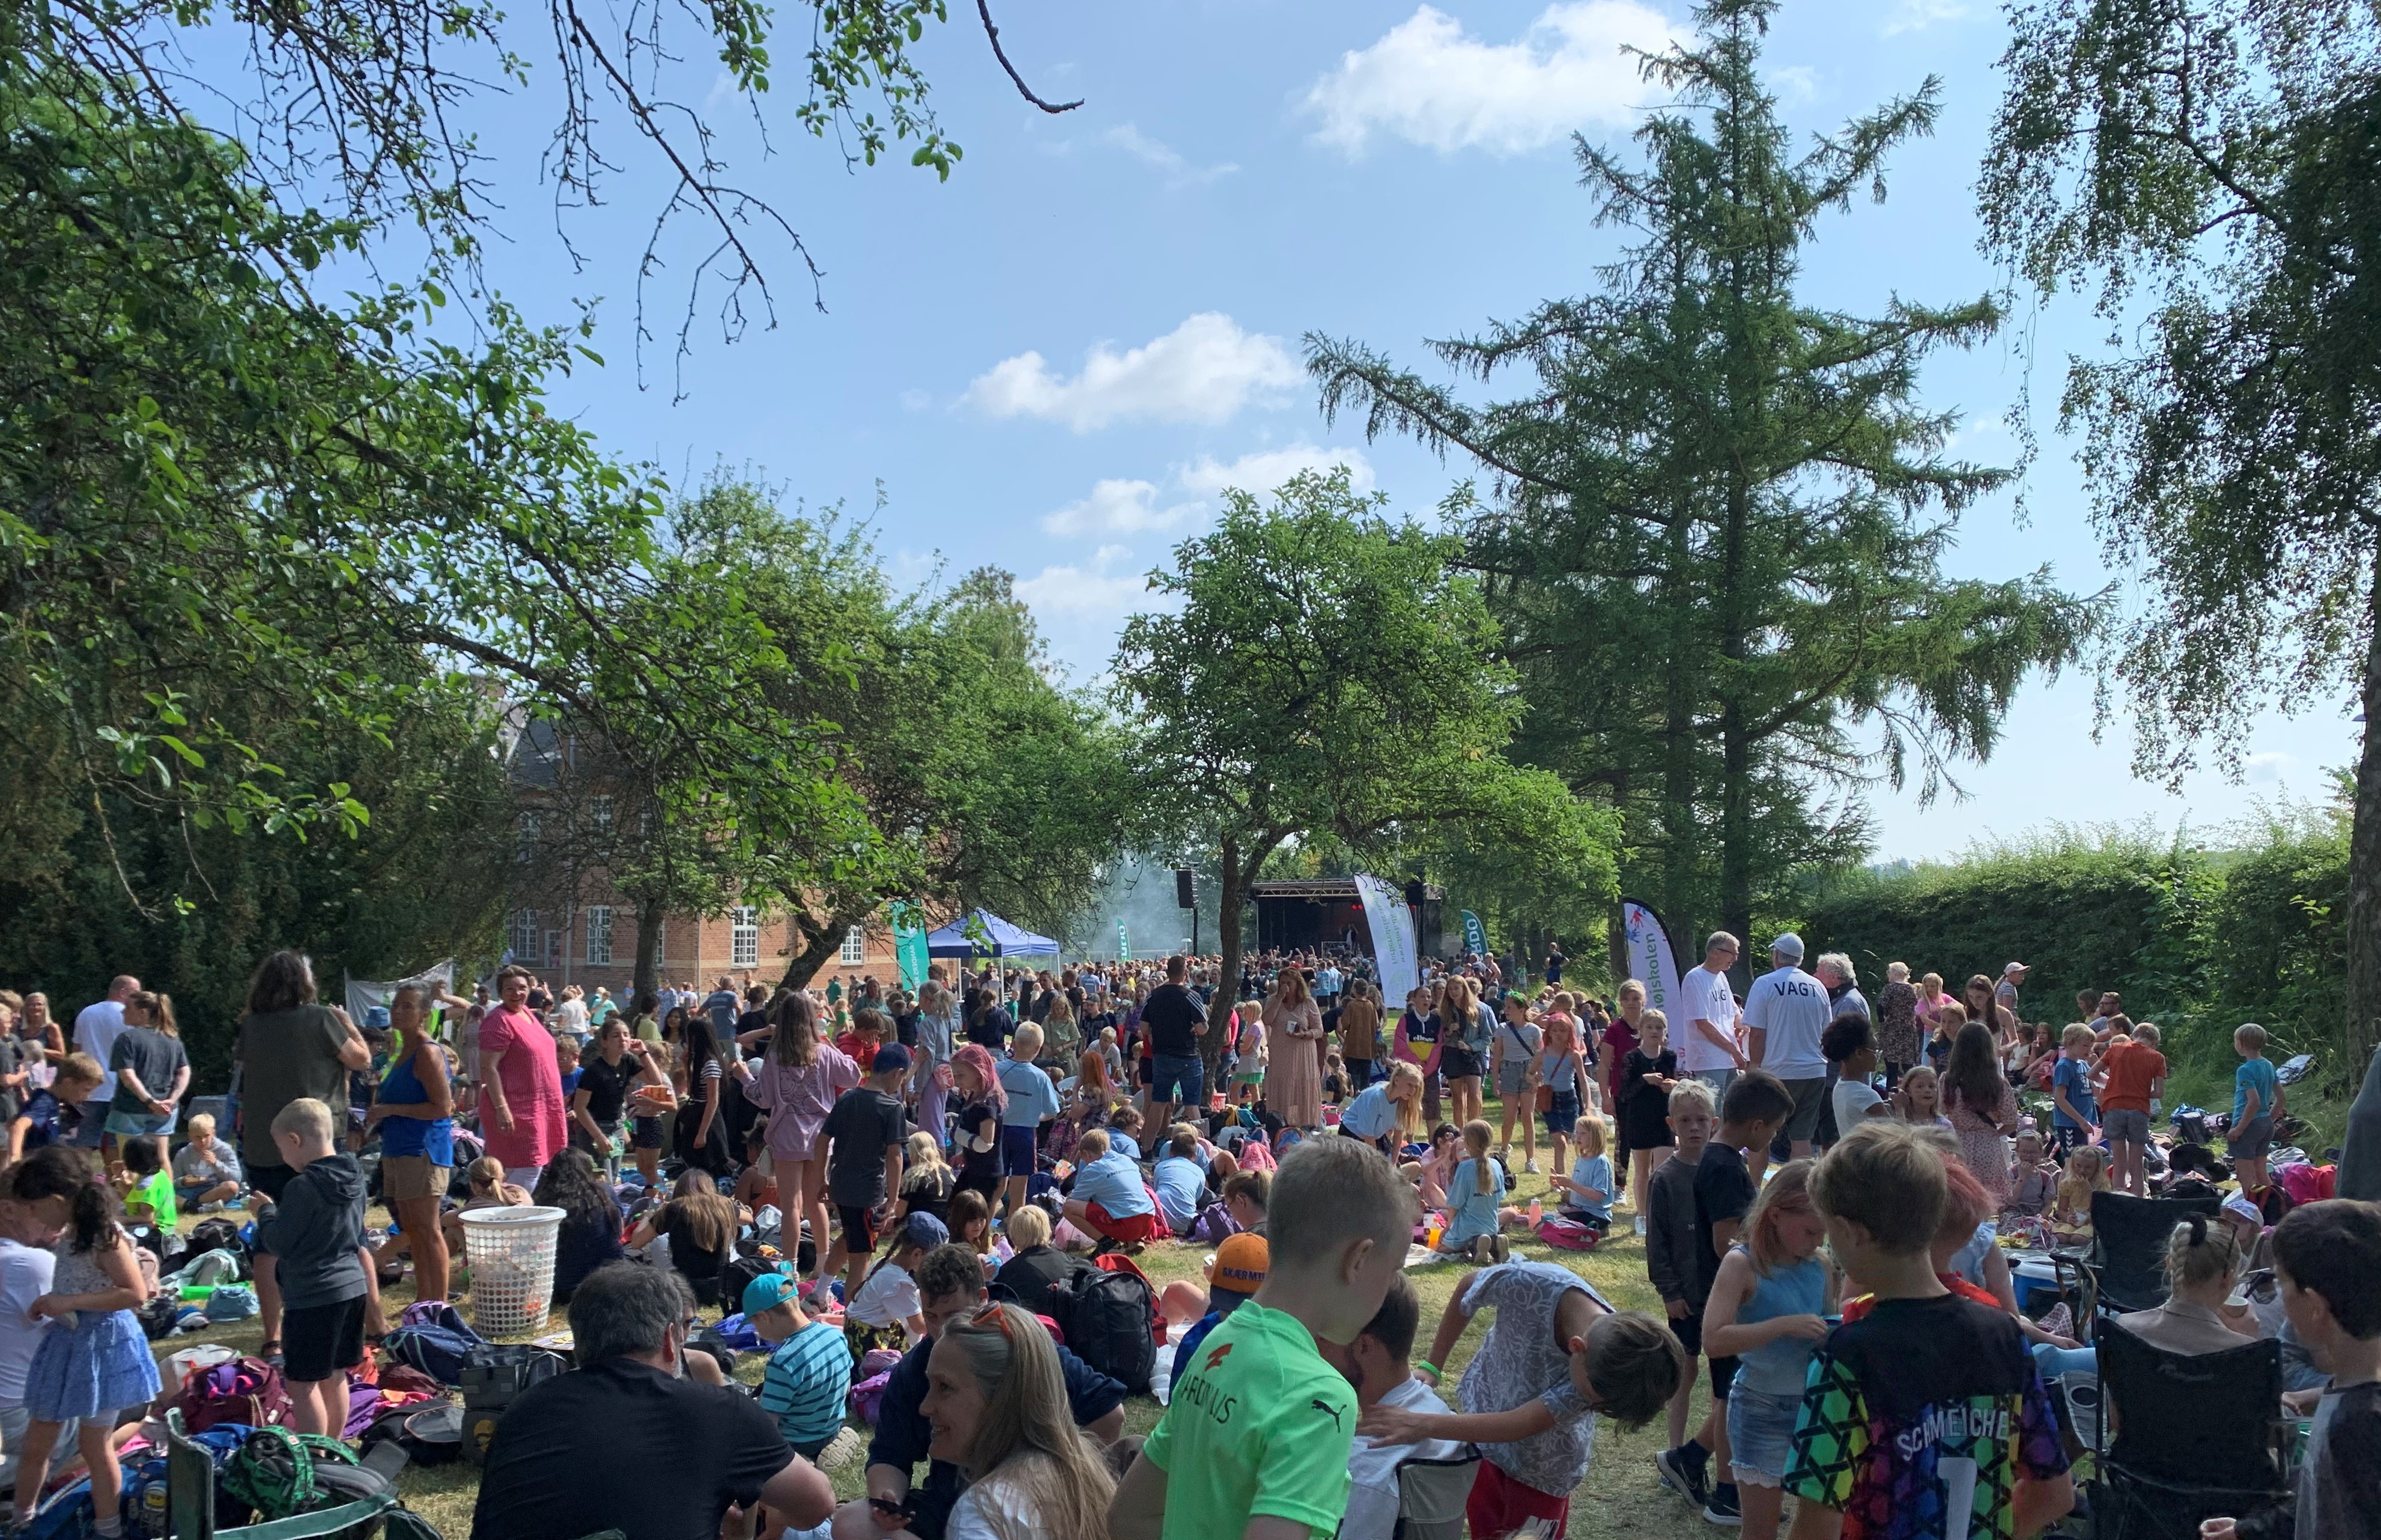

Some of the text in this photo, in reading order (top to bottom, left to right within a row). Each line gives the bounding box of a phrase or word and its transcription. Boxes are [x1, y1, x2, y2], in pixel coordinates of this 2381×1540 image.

[1467, 918, 1484, 961] RDO
[1774, 981, 1816, 998] VAGT
[1897, 1407, 2010, 1461] SCHMEICHE
[1937, 1457, 1978, 1540] 1
